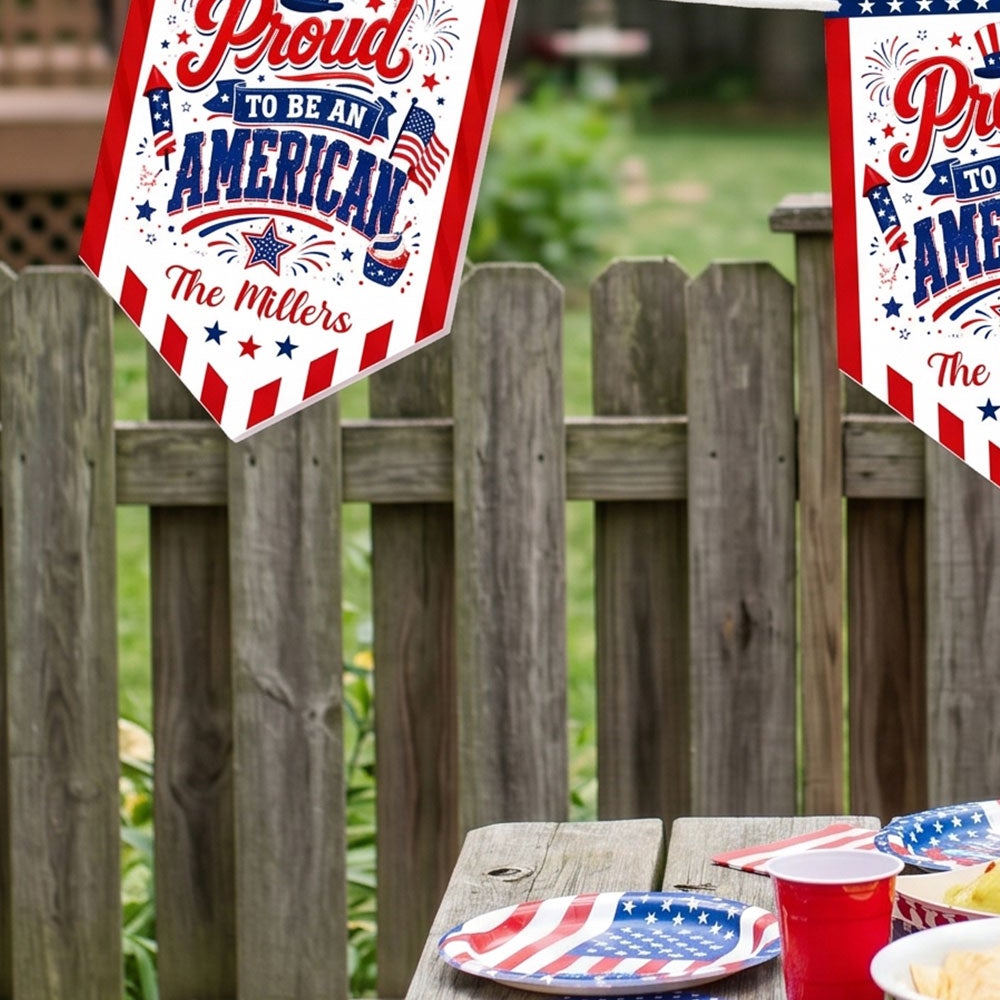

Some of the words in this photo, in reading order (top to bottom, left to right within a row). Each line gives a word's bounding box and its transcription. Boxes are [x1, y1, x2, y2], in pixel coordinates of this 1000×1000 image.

[244, 94, 282, 119] TO
[287, 95, 322, 121] BE
[327, 101, 368, 129] AN
[167, 128, 409, 239] AMERICAN
[964, 167, 998, 193] TO
[165, 264, 225, 307] The
[233, 279, 352, 334] Millers
[927, 352, 990, 388] The
